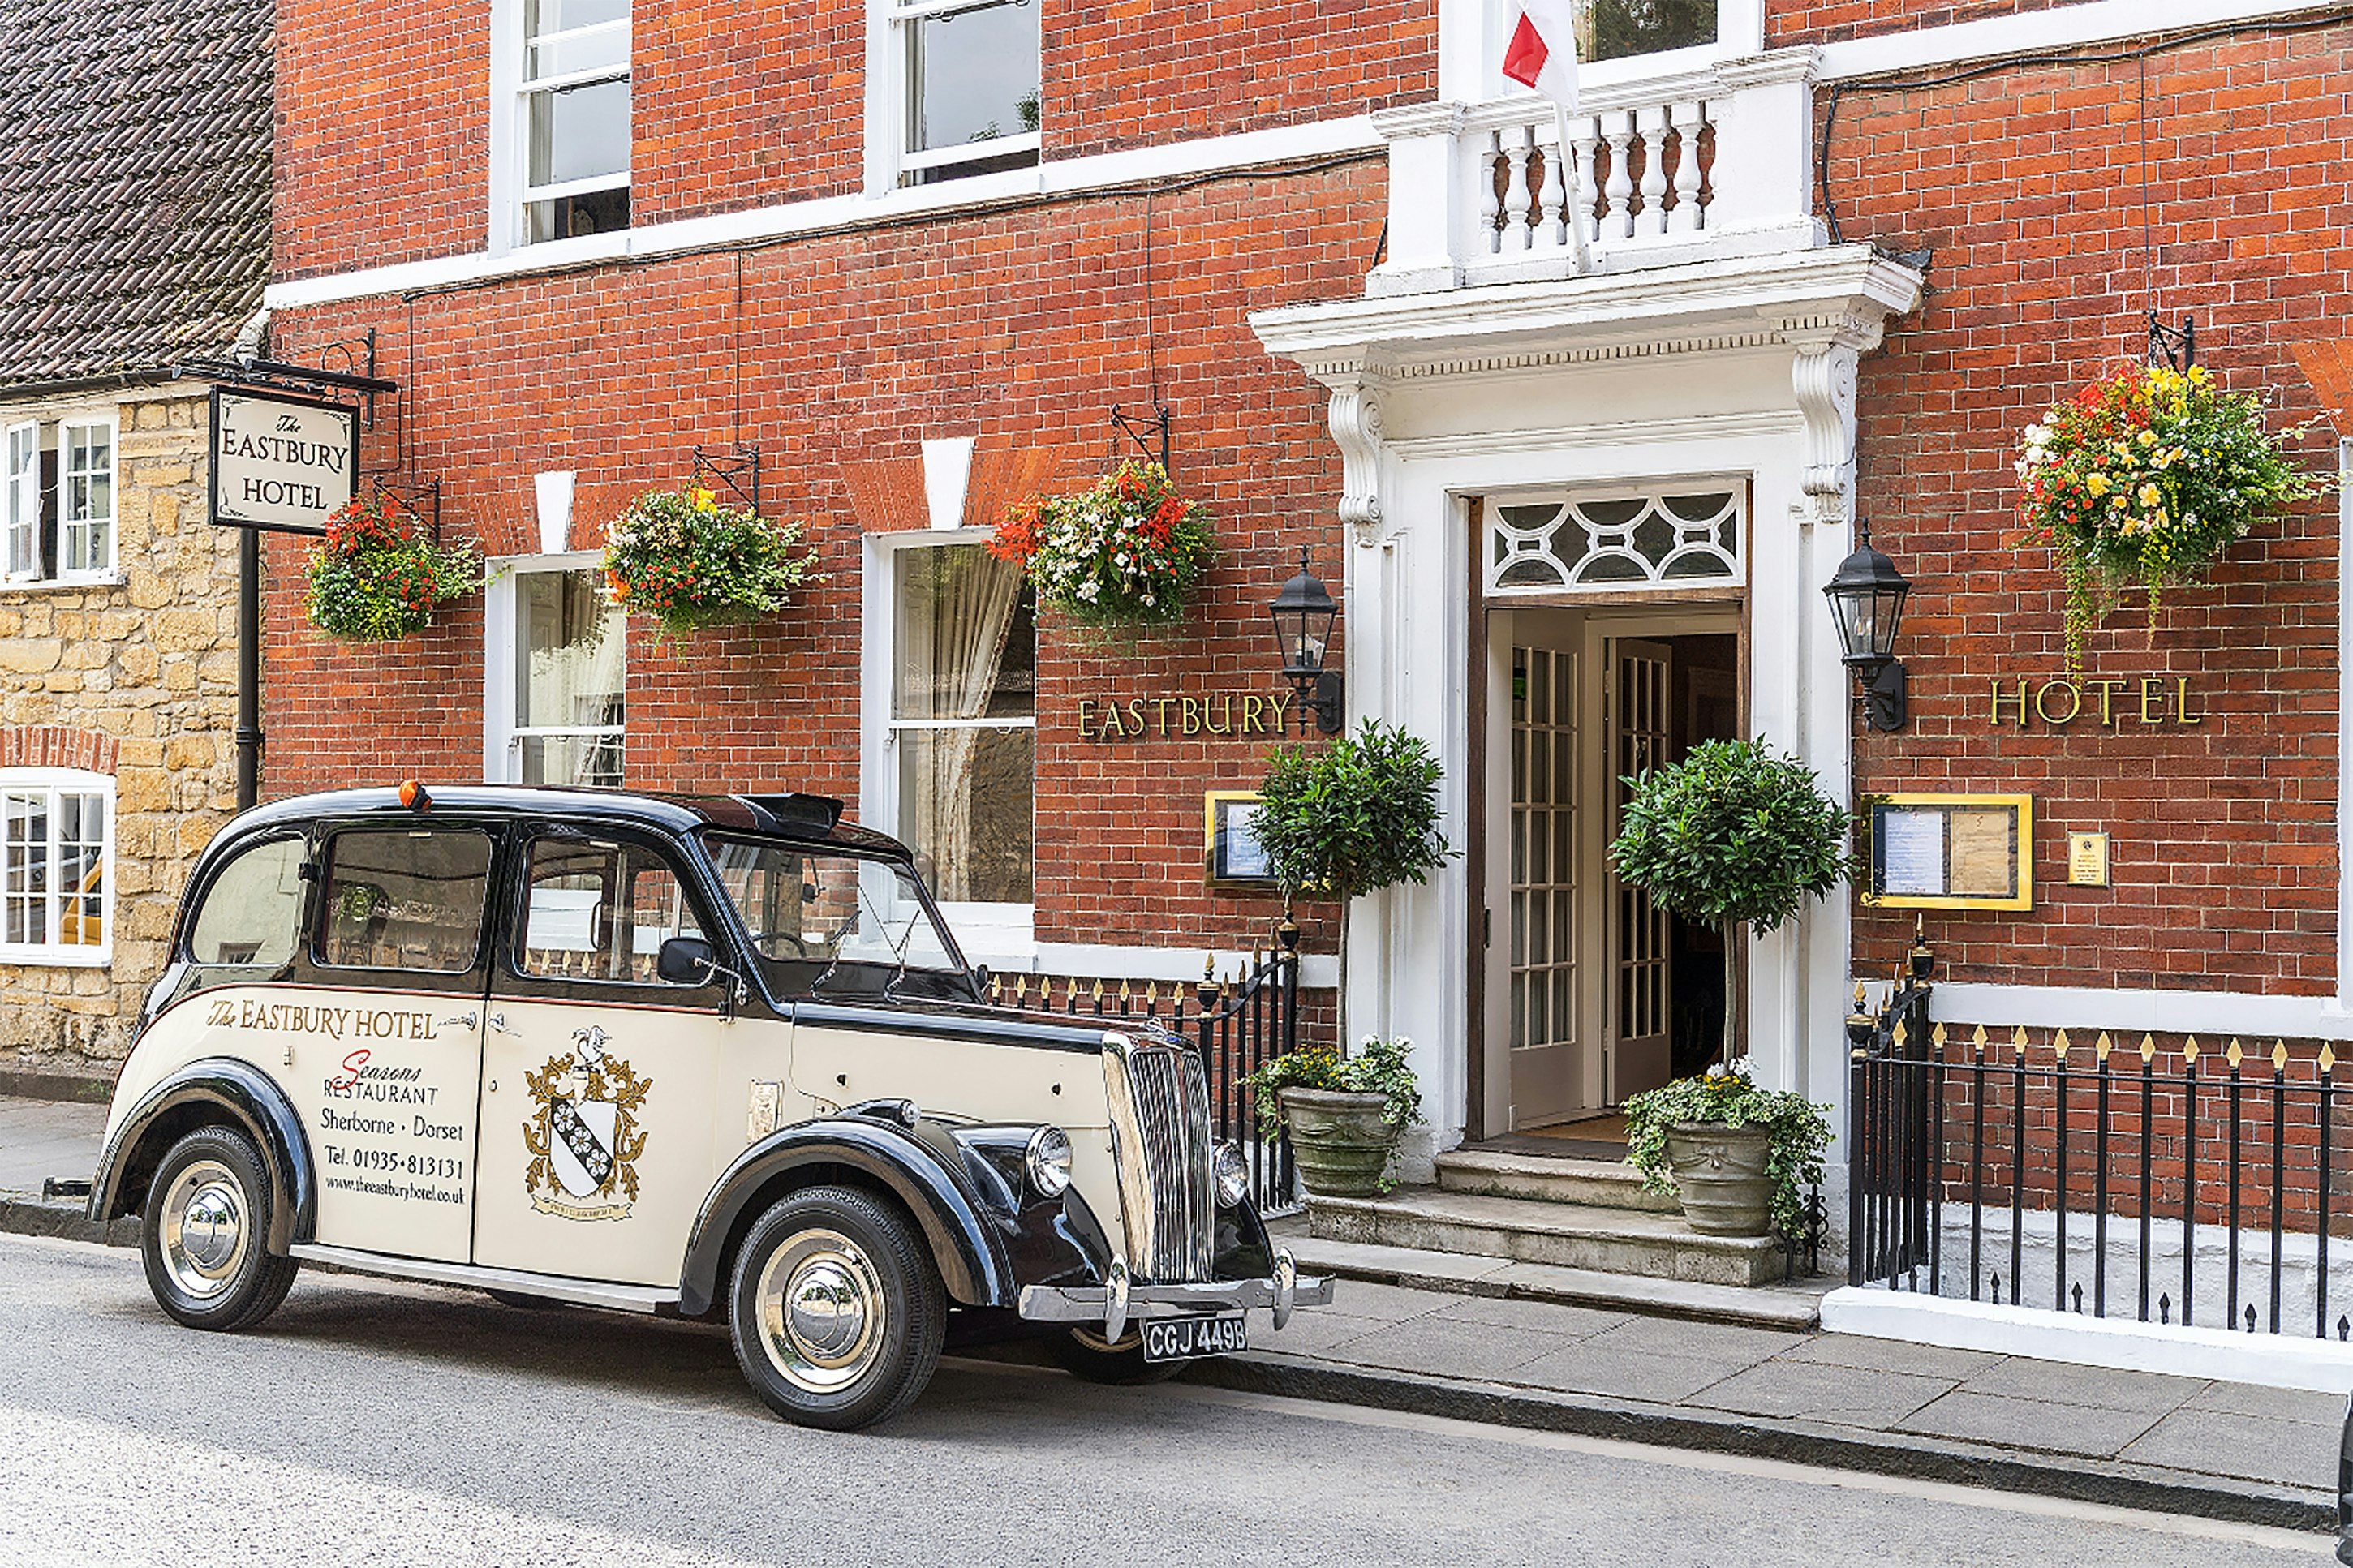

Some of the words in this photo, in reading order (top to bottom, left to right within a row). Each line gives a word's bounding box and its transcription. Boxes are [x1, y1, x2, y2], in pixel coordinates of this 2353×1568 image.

[276, 415, 302, 432] The
[222, 428, 348, 475] EASTBURY
[243, 477, 328, 509] HOTEL
[1078, 694, 1293, 737] EASTBURY
[1990, 677, 2200, 725] HOTEL
[206, 999, 236, 1028] The
[239, 999, 350, 1041] EASTBURY
[355, 1011, 438, 1040] HOTEL
[330, 1049, 422, 1089] Seasons
[324, 1079, 439, 1106] RESTAURANT
[320, 1107, 395, 1135] Sherborne
[414, 1115, 463, 1141] Dorset
[325, 1145, 349, 1166] Tel.
[1150, 1323, 1193, 1356] CGJ
[1198, 1320, 1247, 1352] 449B
